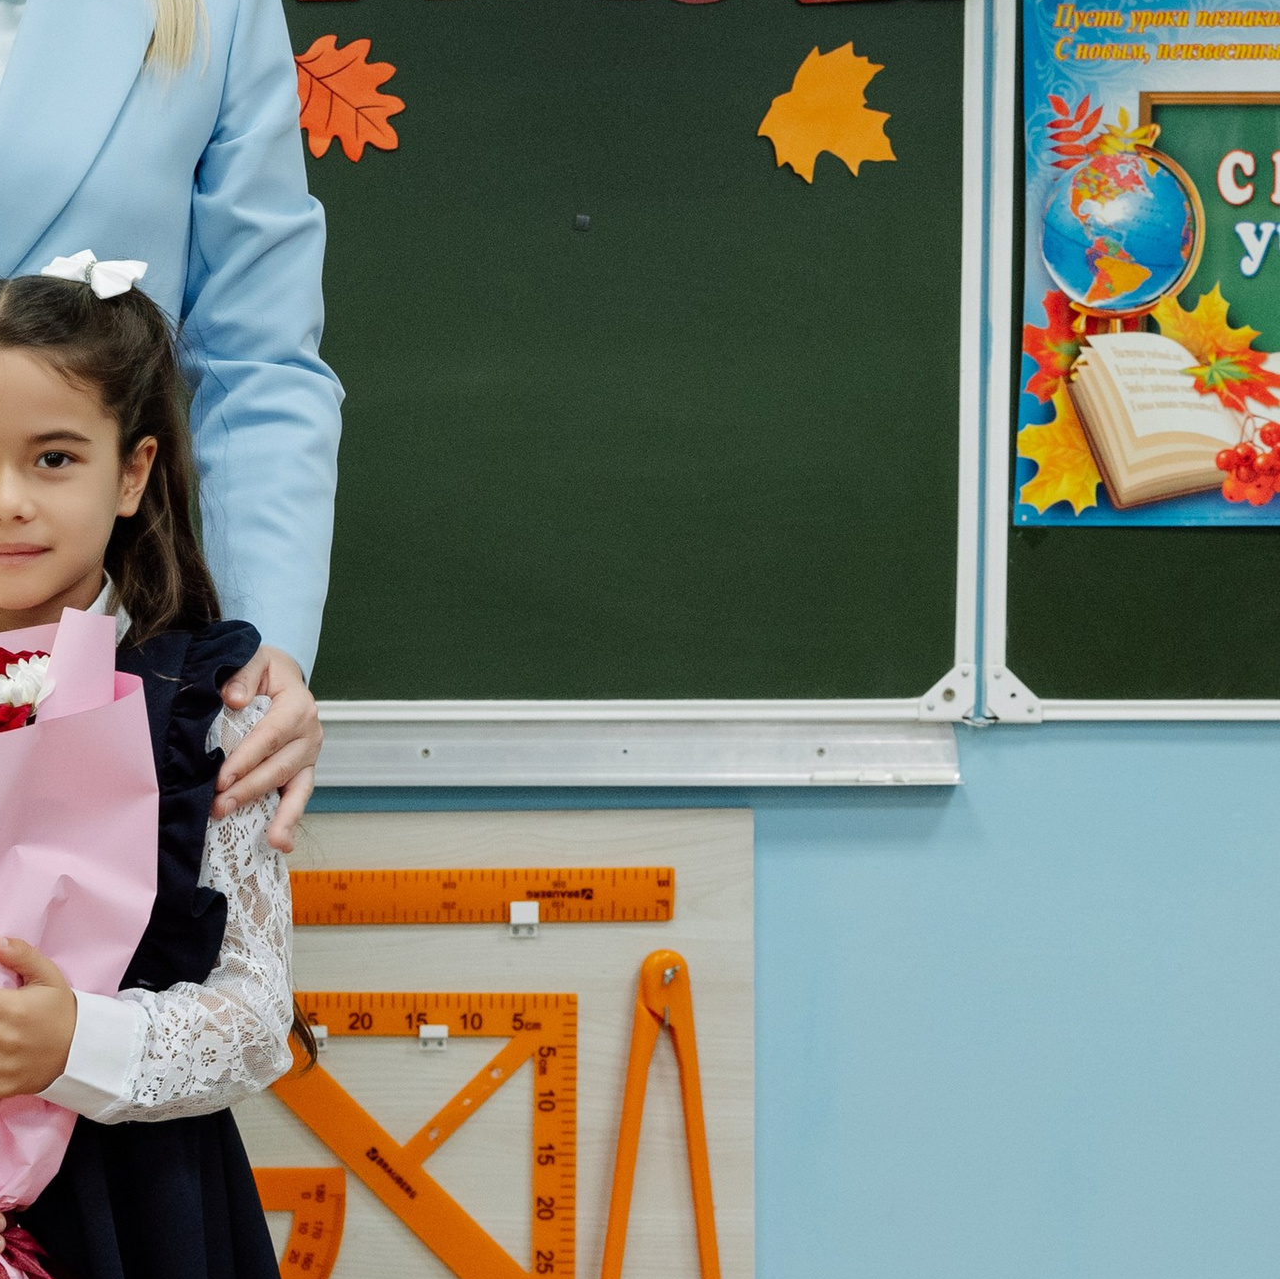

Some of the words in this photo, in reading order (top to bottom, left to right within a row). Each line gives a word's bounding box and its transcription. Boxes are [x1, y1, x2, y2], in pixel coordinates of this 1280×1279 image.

[1051, 3, 1125, 34] Пусть
[1126, 9, 1189, 34] уроки
[1195, 9, 1280, 28] познако
[1054, 37, 1073, 60] С
[1074, 42, 1151, 64] новым,
[1217, 148, 1256, 206] С
[348, 1012, 373, 1031] 20
[460, 1012, 482, 1031] 10
[538, 1090, 556, 1112] 10
[537, 1143, 555, 1166] 15
[536, 1196, 555, 1221] 20
[536, 1250, 555, 1274] 25
